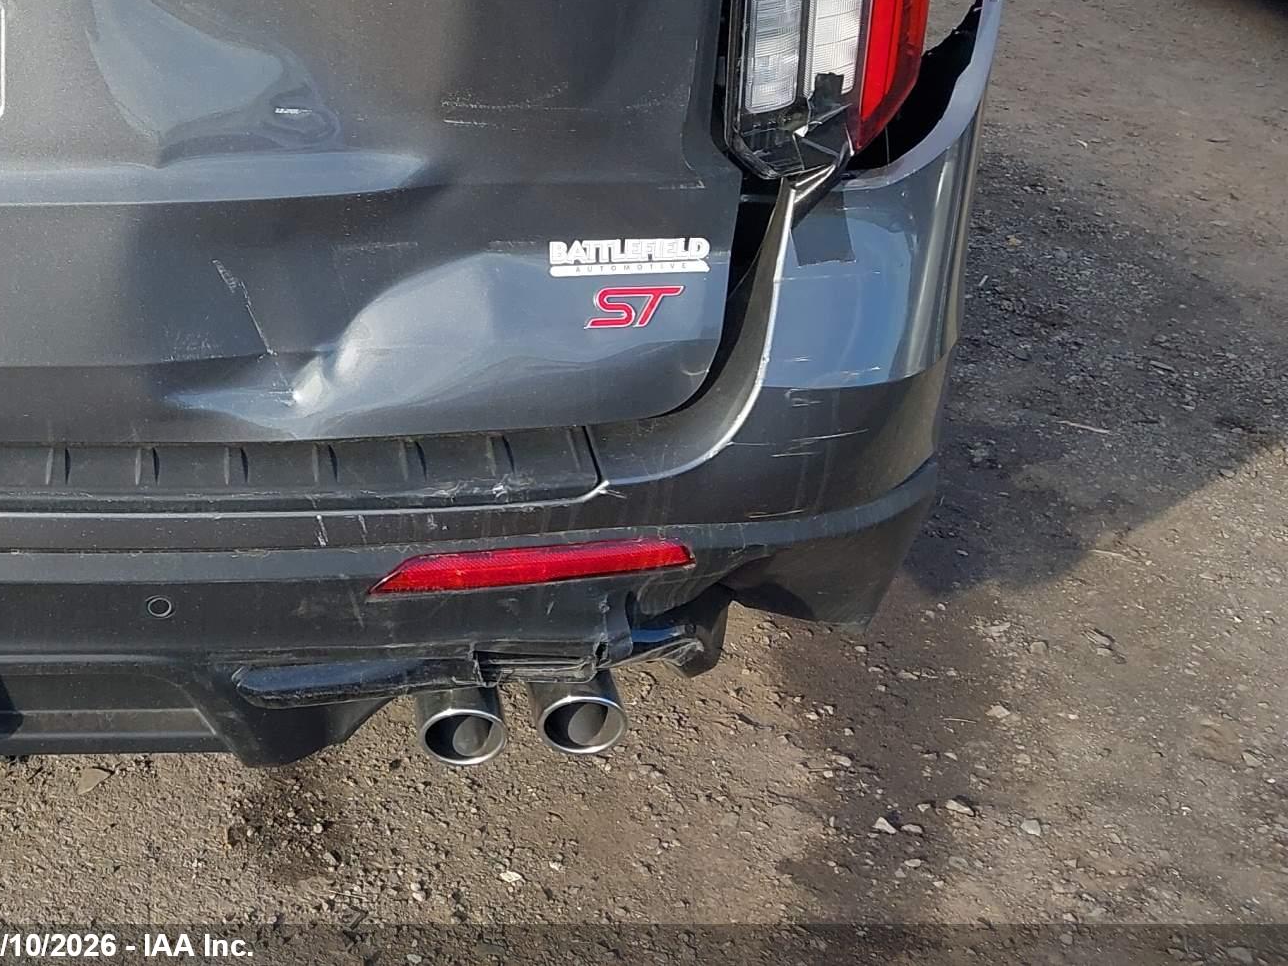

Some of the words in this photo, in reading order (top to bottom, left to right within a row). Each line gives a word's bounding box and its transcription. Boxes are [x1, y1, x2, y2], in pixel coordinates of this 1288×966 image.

[549, 237, 710, 265] BATTLEFIELD
[575, 262, 687, 273] AUTOMOTIVE
[584, 285, 684, 329] ST
